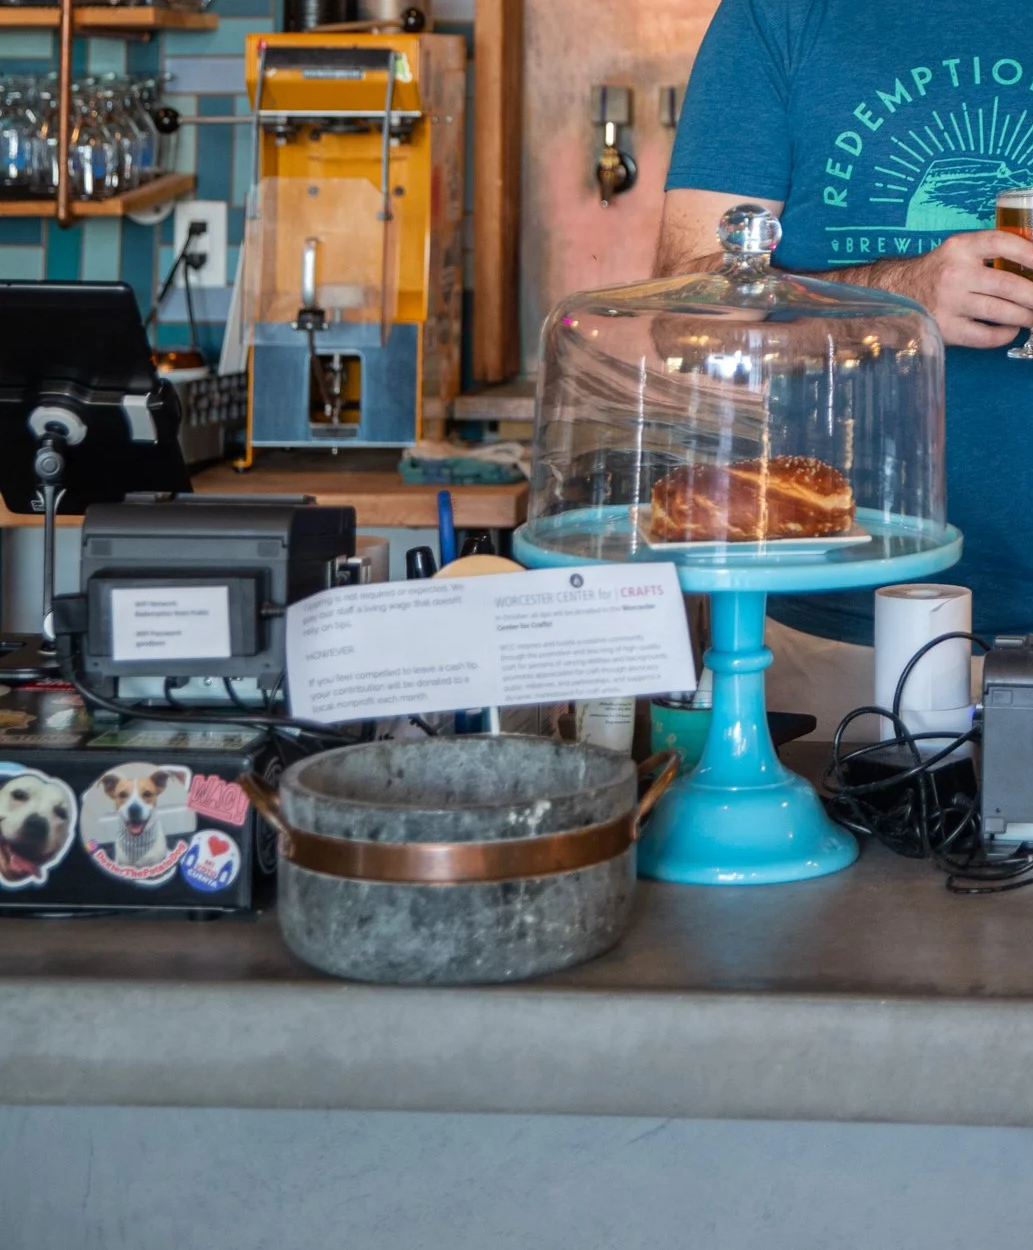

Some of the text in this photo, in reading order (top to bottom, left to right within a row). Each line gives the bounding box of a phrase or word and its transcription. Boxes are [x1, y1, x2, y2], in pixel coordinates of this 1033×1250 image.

[846, 237, 942, 254] BREWIN
[495, 592, 552, 609] WORCESTER
[556, 589, 595, 603] CENTER
[621, 585, 664, 598] CRAFTS
